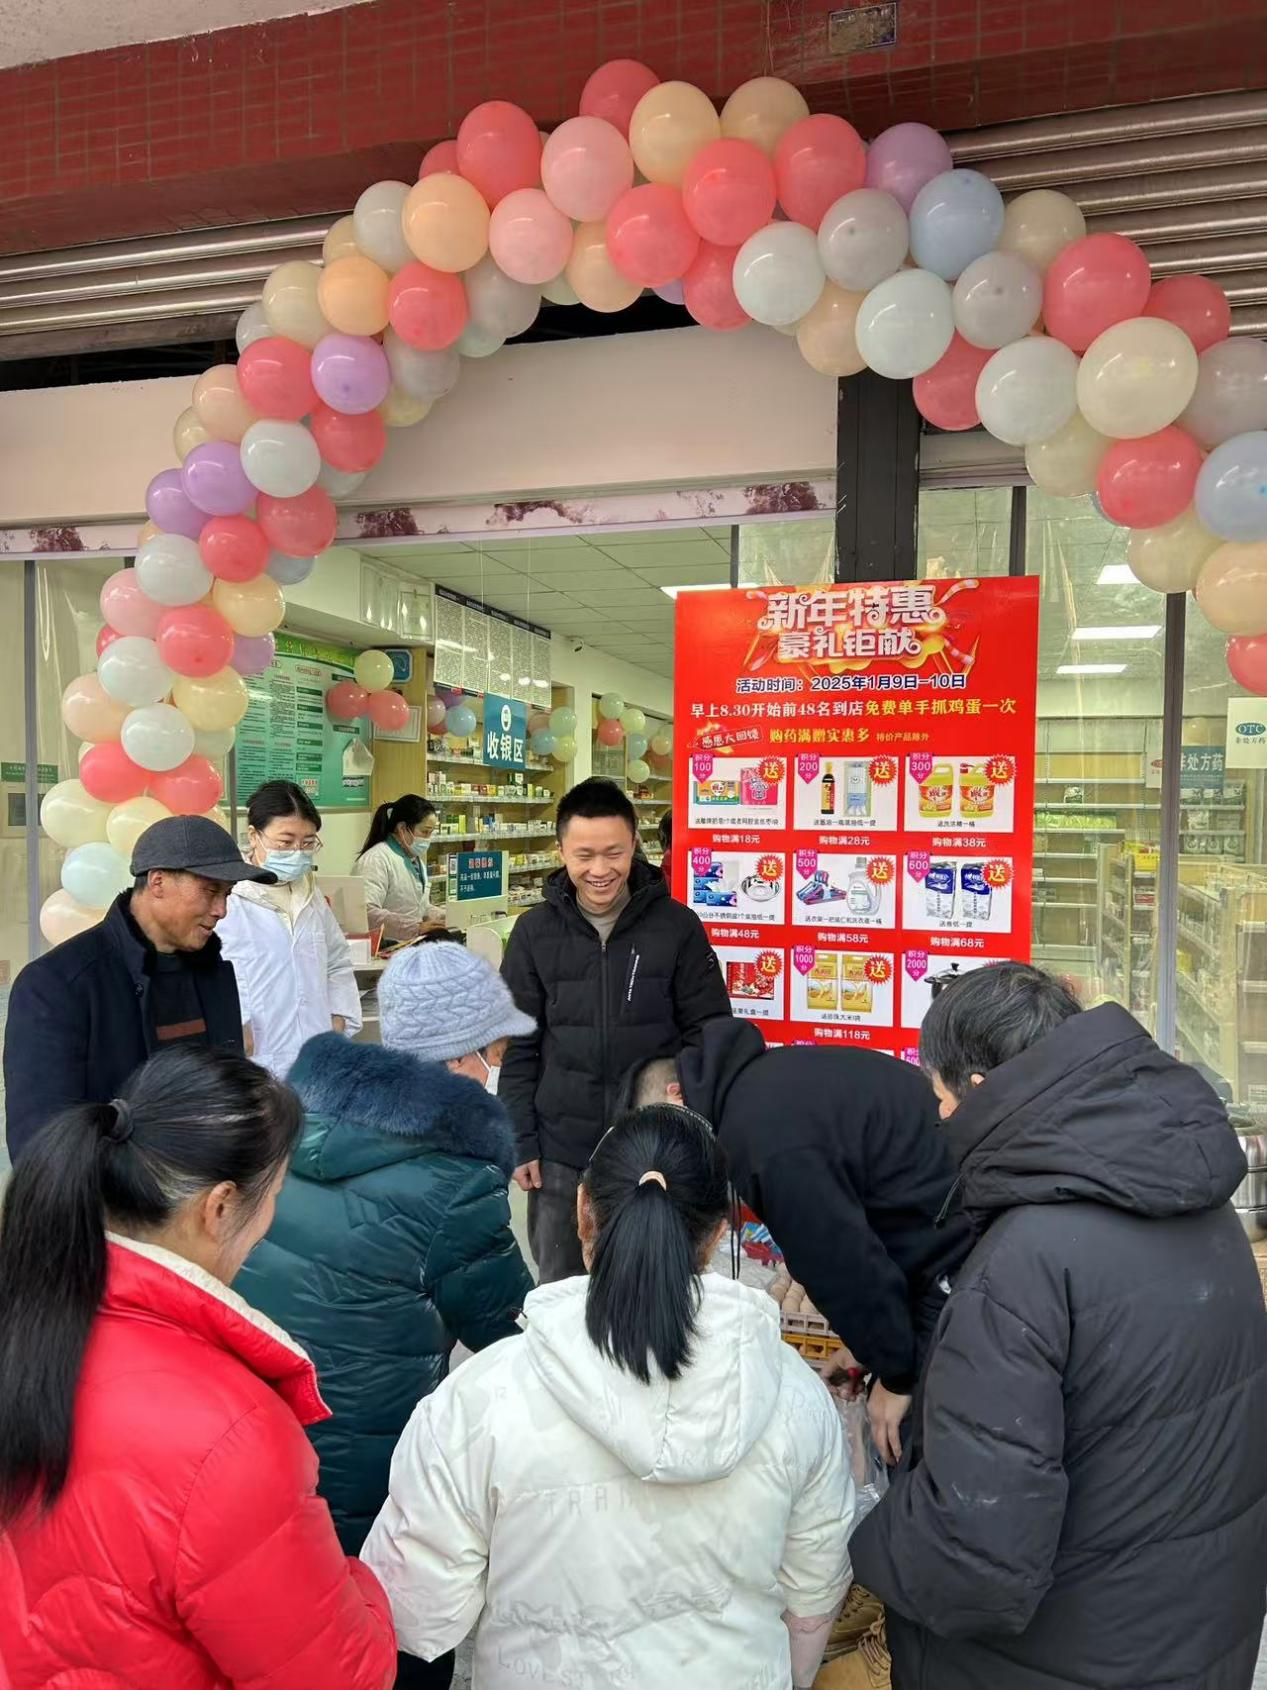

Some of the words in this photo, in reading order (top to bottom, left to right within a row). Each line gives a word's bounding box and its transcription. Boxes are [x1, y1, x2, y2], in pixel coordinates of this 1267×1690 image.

[760, 584, 945, 630] 新年特惠
[778, 629, 921, 659] 豪礼钜献
[1238, 725, 1264, 734] OTC
[770, 728, 871, 744] 购药满赠实惠多
[487, 731, 524, 763] 收银区
[694, 762, 711, 771] 100
[763, 761, 779, 779] 送
[799, 763, 818, 772] 200
[875, 761, 890, 779] 送
[911, 762, 930, 771] 300
[992, 761, 1008, 779] 送
[712, 834, 760, 844] 购物满18元
[819, 836, 870, 846] 购物满28元
[932, 837, 986, 847] 购物满38元
[693, 856, 710, 865] 400
[798, 858, 816, 867] 500
[909, 860, 928, 869] 600
[762, 859, 777, 876] 送
[873, 861, 888, 879] 送
[989, 864, 1005, 882] 送
[711, 928, 759, 939] 购物满48元
[817, 932, 868, 943] 购物满58元
[930, 936, 985, 948] 购物满68元
[761, 955, 777, 973] 送
[795, 955, 814, 964] 1000
[907, 959, 927, 969] 2000
[870, 961, 887, 978] 送
[814, 1027, 870, 1040] 购物满118元
